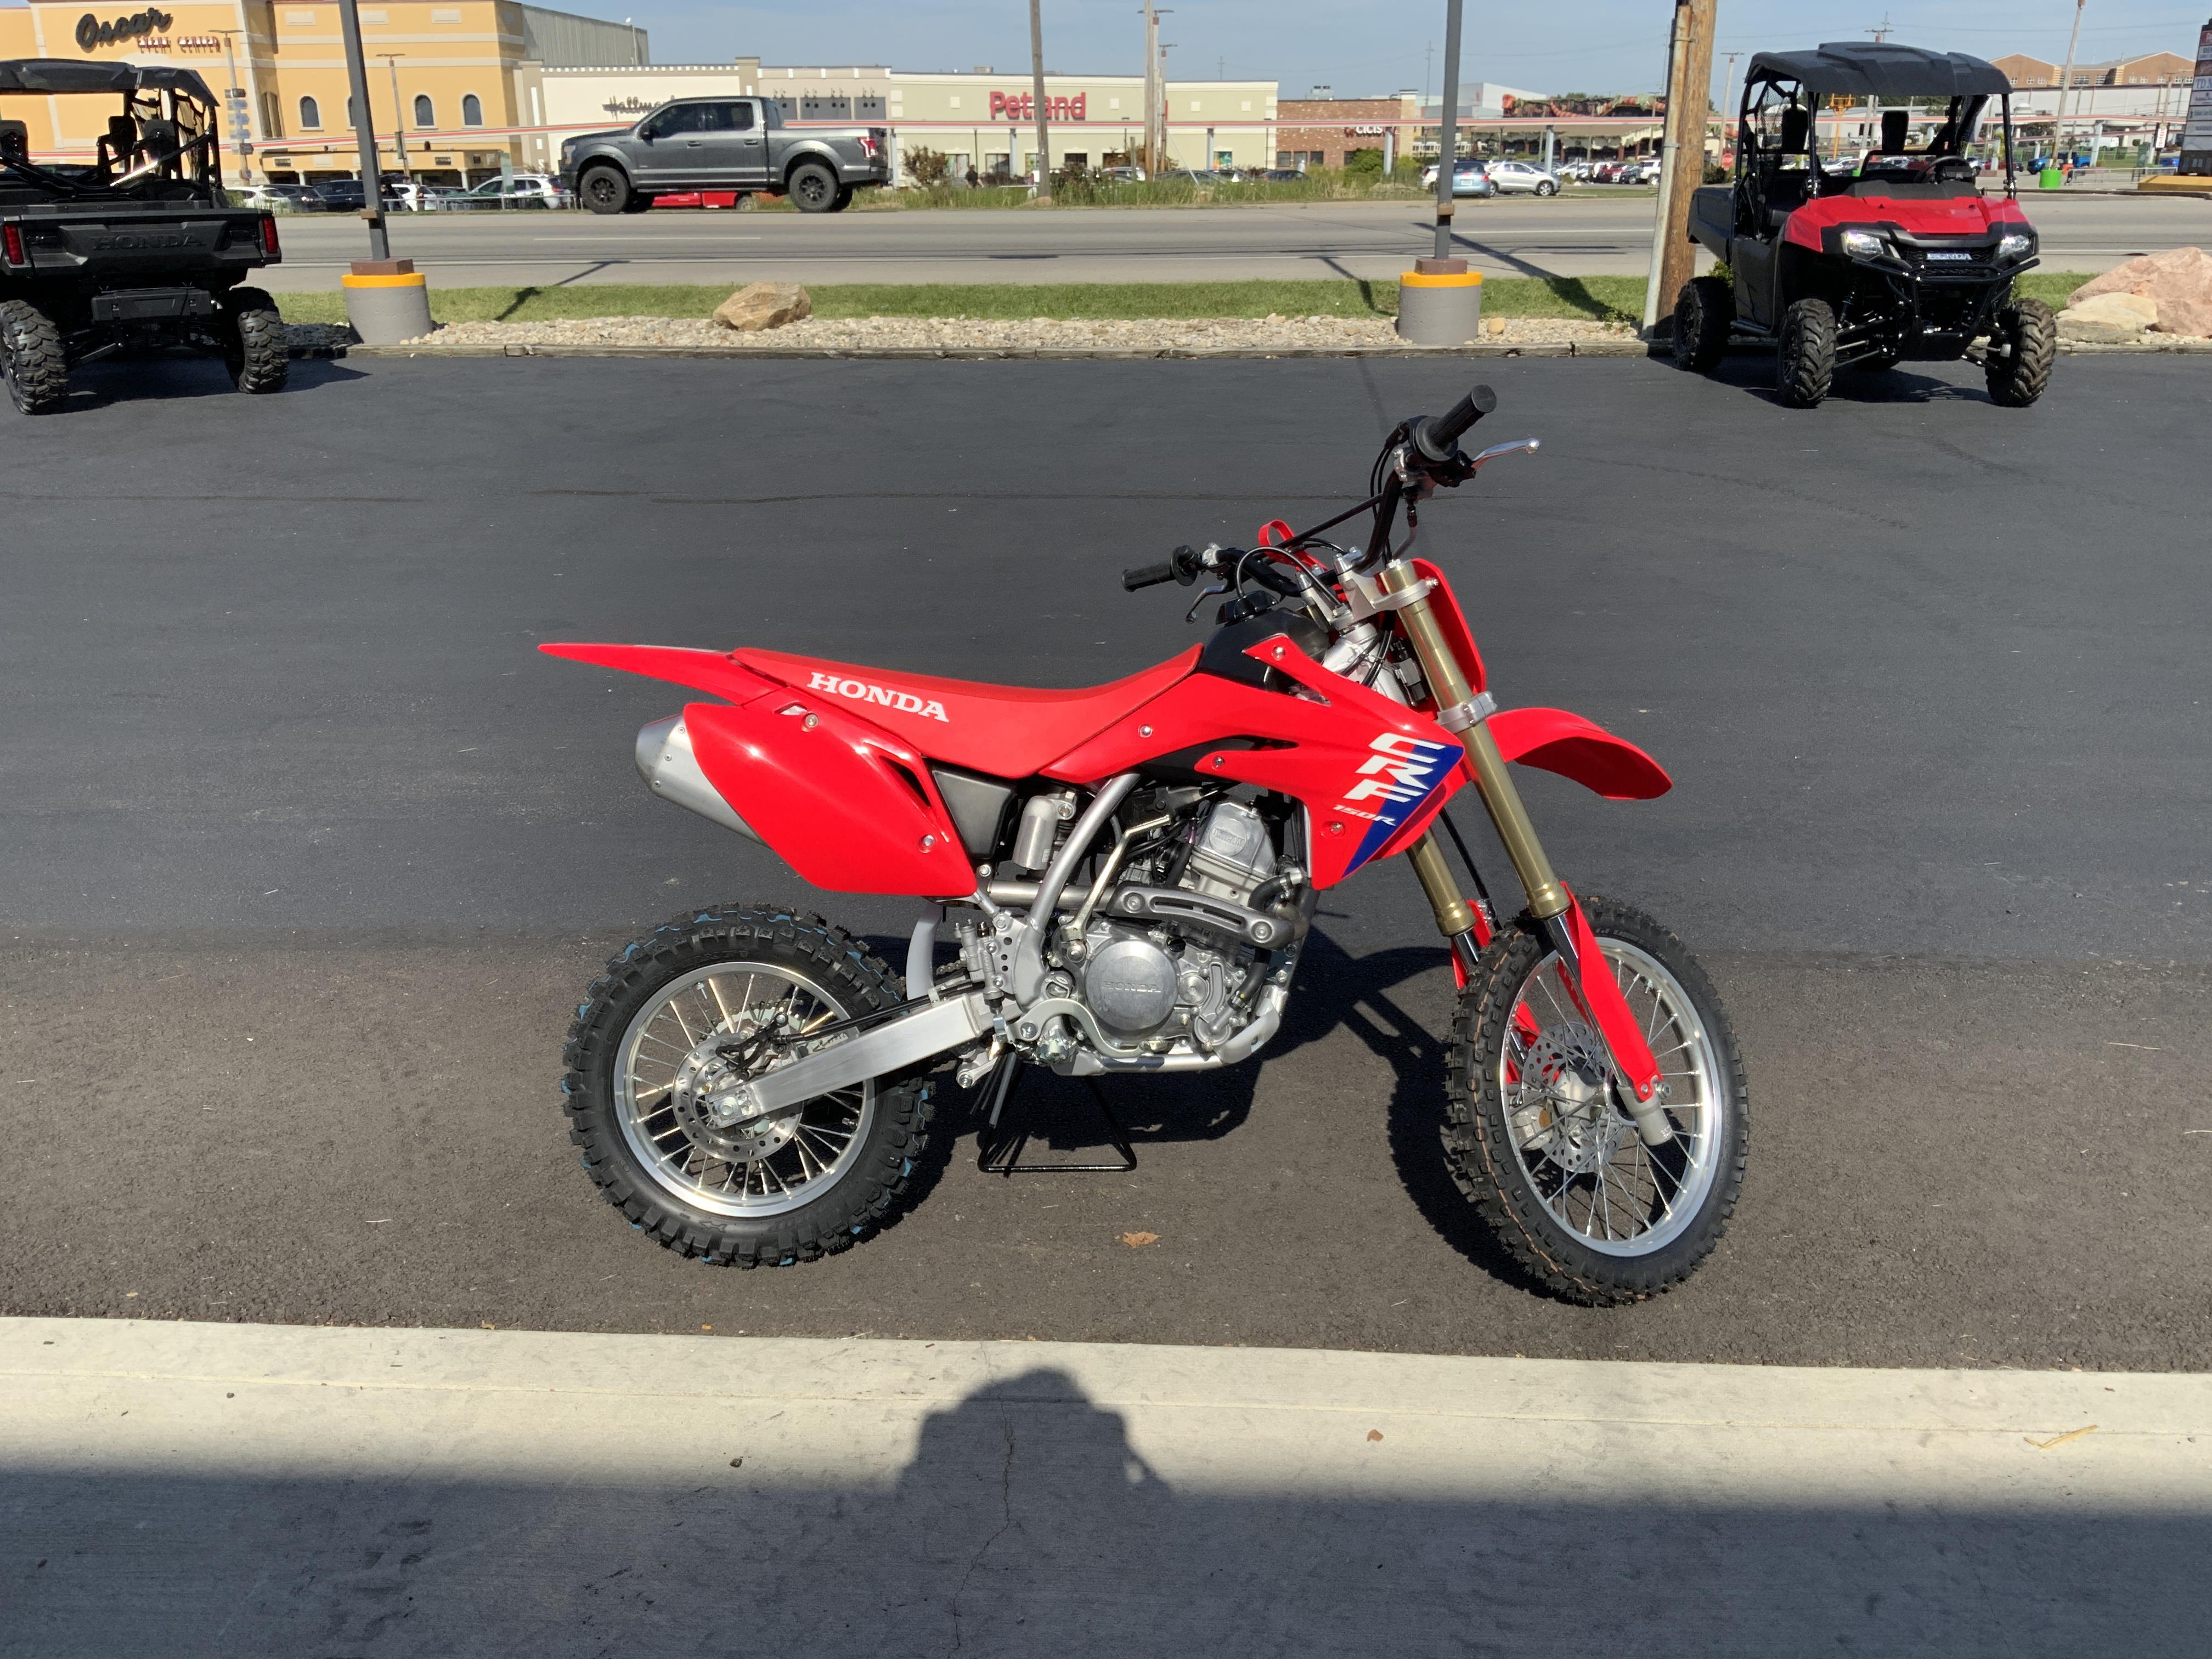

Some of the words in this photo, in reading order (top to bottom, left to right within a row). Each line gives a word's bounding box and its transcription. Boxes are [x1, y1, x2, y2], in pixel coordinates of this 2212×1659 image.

[76, 8, 172, 49] Oscar
[138, 36, 172, 51] EVENT
[177, 36, 221, 51] CENTER
[990, 91, 1086, 120] Petand
[91, 234, 206, 250] HONDA
[806, 672, 949, 723] HONDA
[1342, 732, 1446, 803] CRF
[1332, 804, 1397, 826] 150R
[1101, 980, 1161, 993] HONDA
